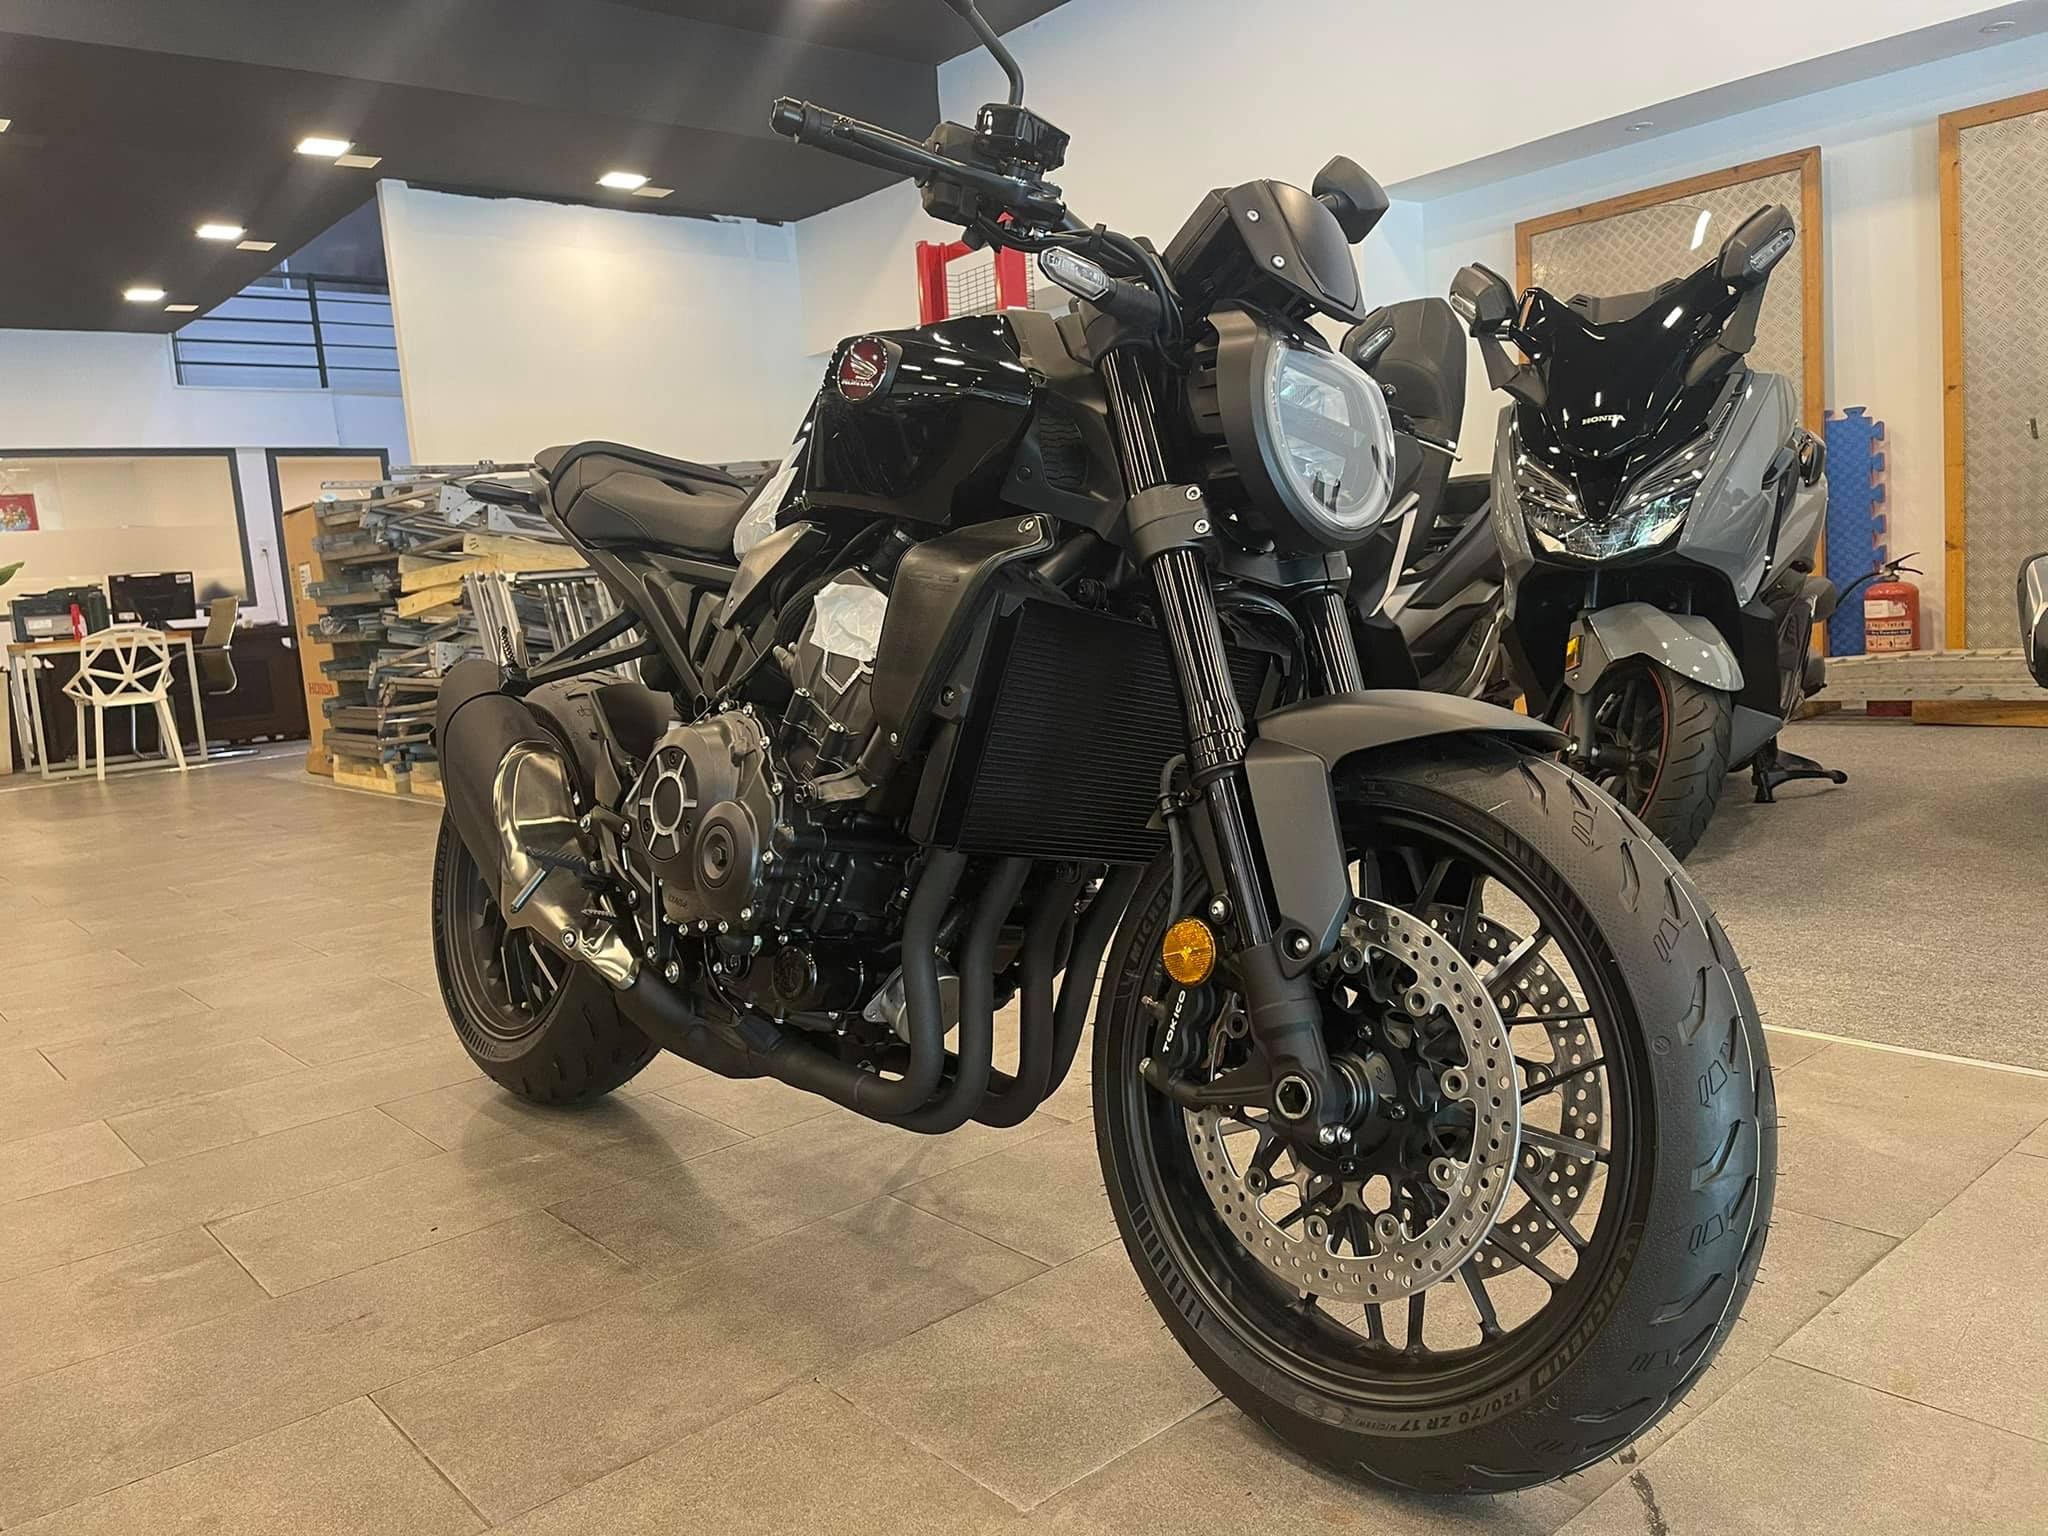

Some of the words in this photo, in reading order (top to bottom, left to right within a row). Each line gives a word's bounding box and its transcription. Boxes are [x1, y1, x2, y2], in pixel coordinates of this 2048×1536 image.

[308, 682, 335, 696] HONDA
[1162, 990, 1186, 1053] TOKICO
[1535, 1262, 1627, 1388] MICHELIN
[1458, 1388, 1521, 1425] 120/70
[1399, 1419, 1421, 1432] 17
[1426, 1415, 1452, 1431] ZR
